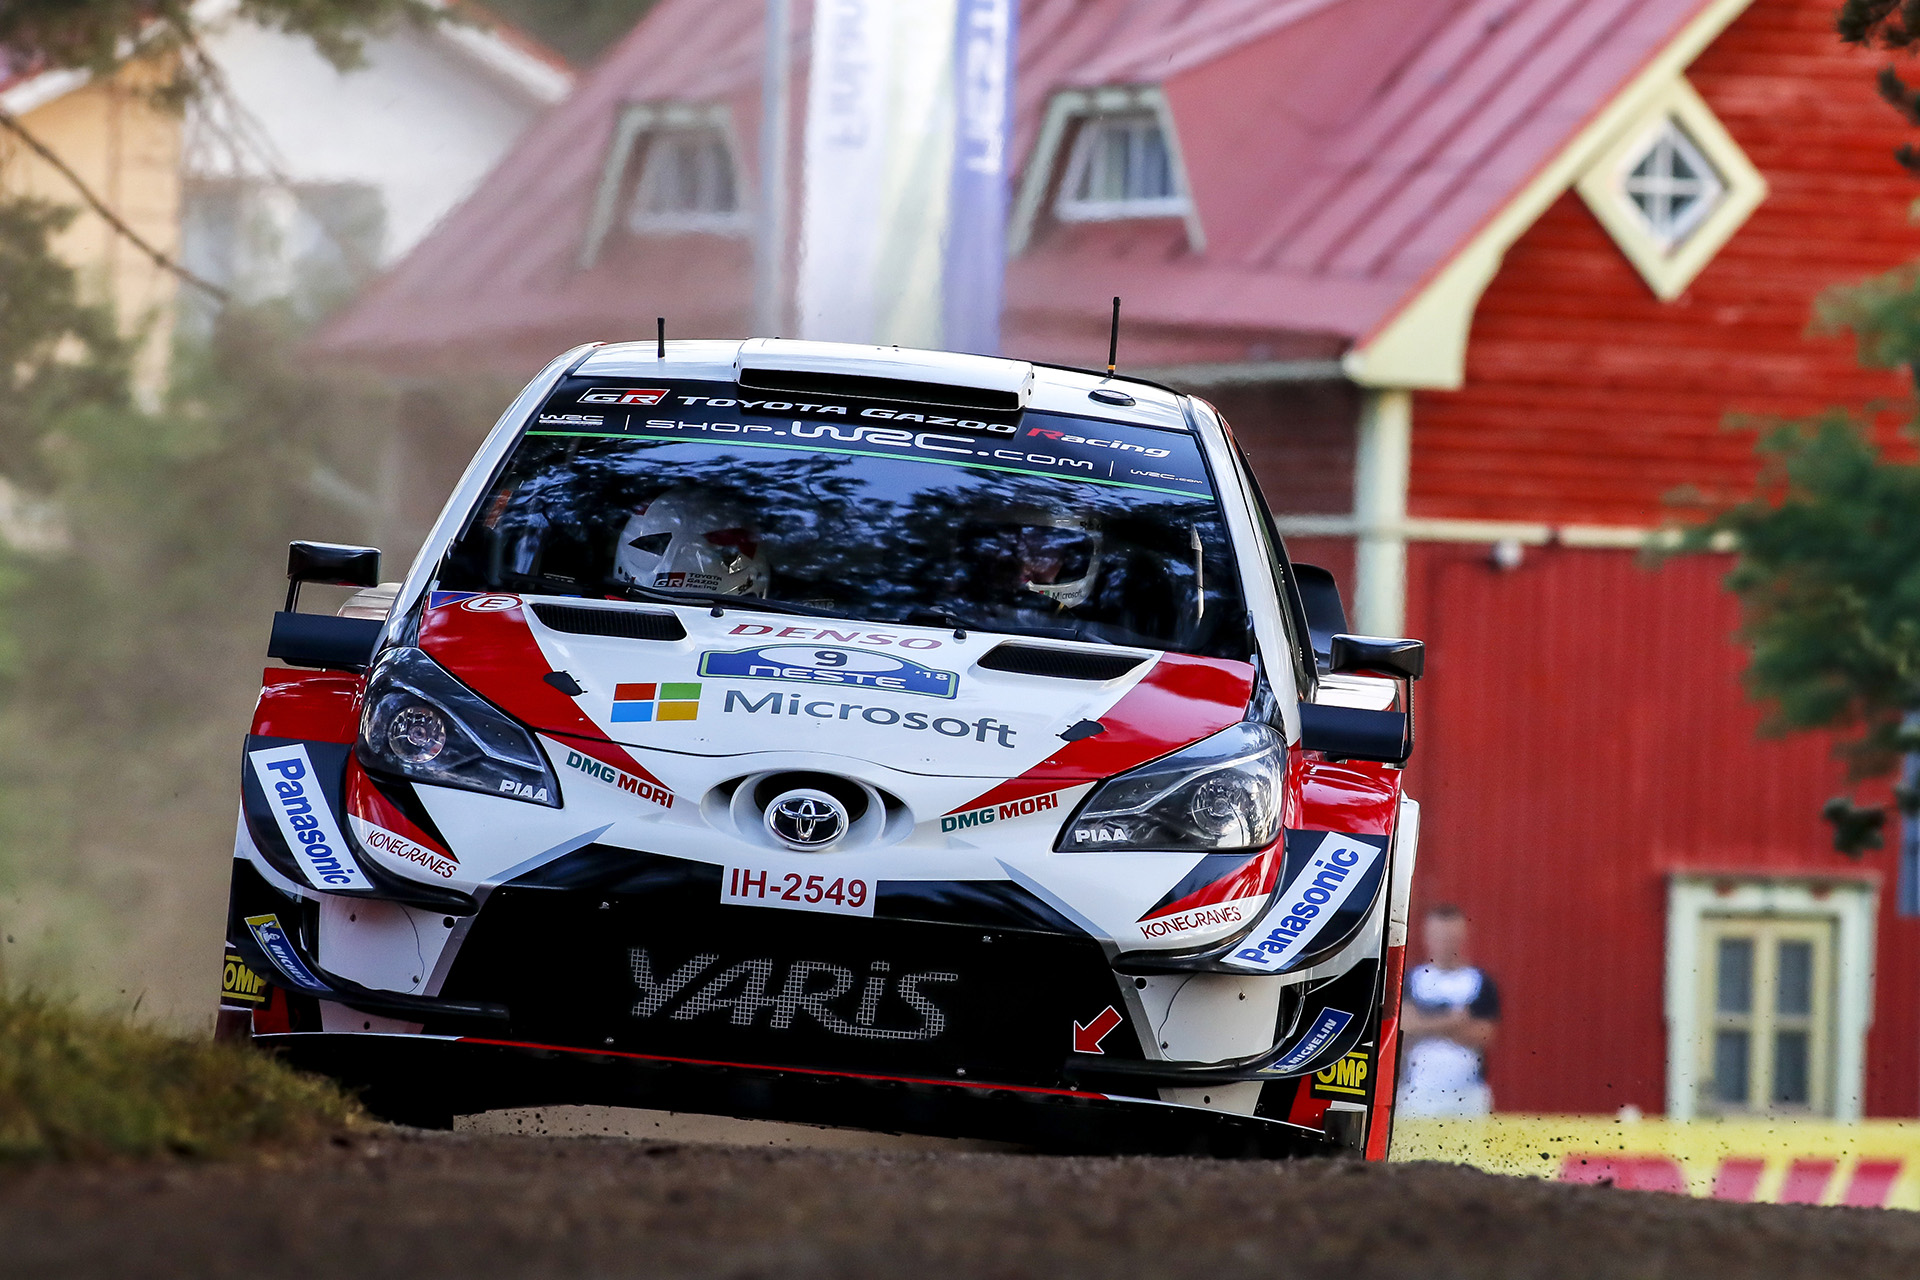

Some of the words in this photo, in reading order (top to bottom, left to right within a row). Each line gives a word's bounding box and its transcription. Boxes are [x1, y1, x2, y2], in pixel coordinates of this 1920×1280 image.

[540, 413, 604, 422] WRC
[582, 392, 661, 404] GR
[677, 395, 848, 416] TOYOTA
[860, 408, 1018, 434] GAZOO
[1026, 427, 1171, 458] Racing
[653, 578, 681, 587] GR
[687, 578, 719, 586] GAZOO
[685, 583, 718, 591] Racing
[688, 572, 723, 581] TOYOTA
[728, 624, 942, 650] DENSO
[814, 650, 848, 667] 9
[749, 665, 906, 689] NESTE
[723, 690, 1017, 749] Microsoft
[499, 779, 548, 802] PIAA
[566, 751, 615, 784] DMG
[617, 773, 675, 809] MORI
[266, 758, 355, 886] Panasonic
[941, 808, 995, 833] DMG
[999, 793, 1058, 820] MORI
[1074, 828, 1128, 843] PIAA
[366, 830, 458, 879] KONECRANES
[729, 868, 868, 908] IH-2549
[1140, 905, 1242, 940] KONECRANES
[1235, 848, 1359, 965] Panasonic
[223, 962, 267, 994] OMP
[270, 944, 318, 987] MICHELIN
[1288, 1018, 1337, 1065] MICHELIN
[1316, 1058, 1368, 1088] OMP
